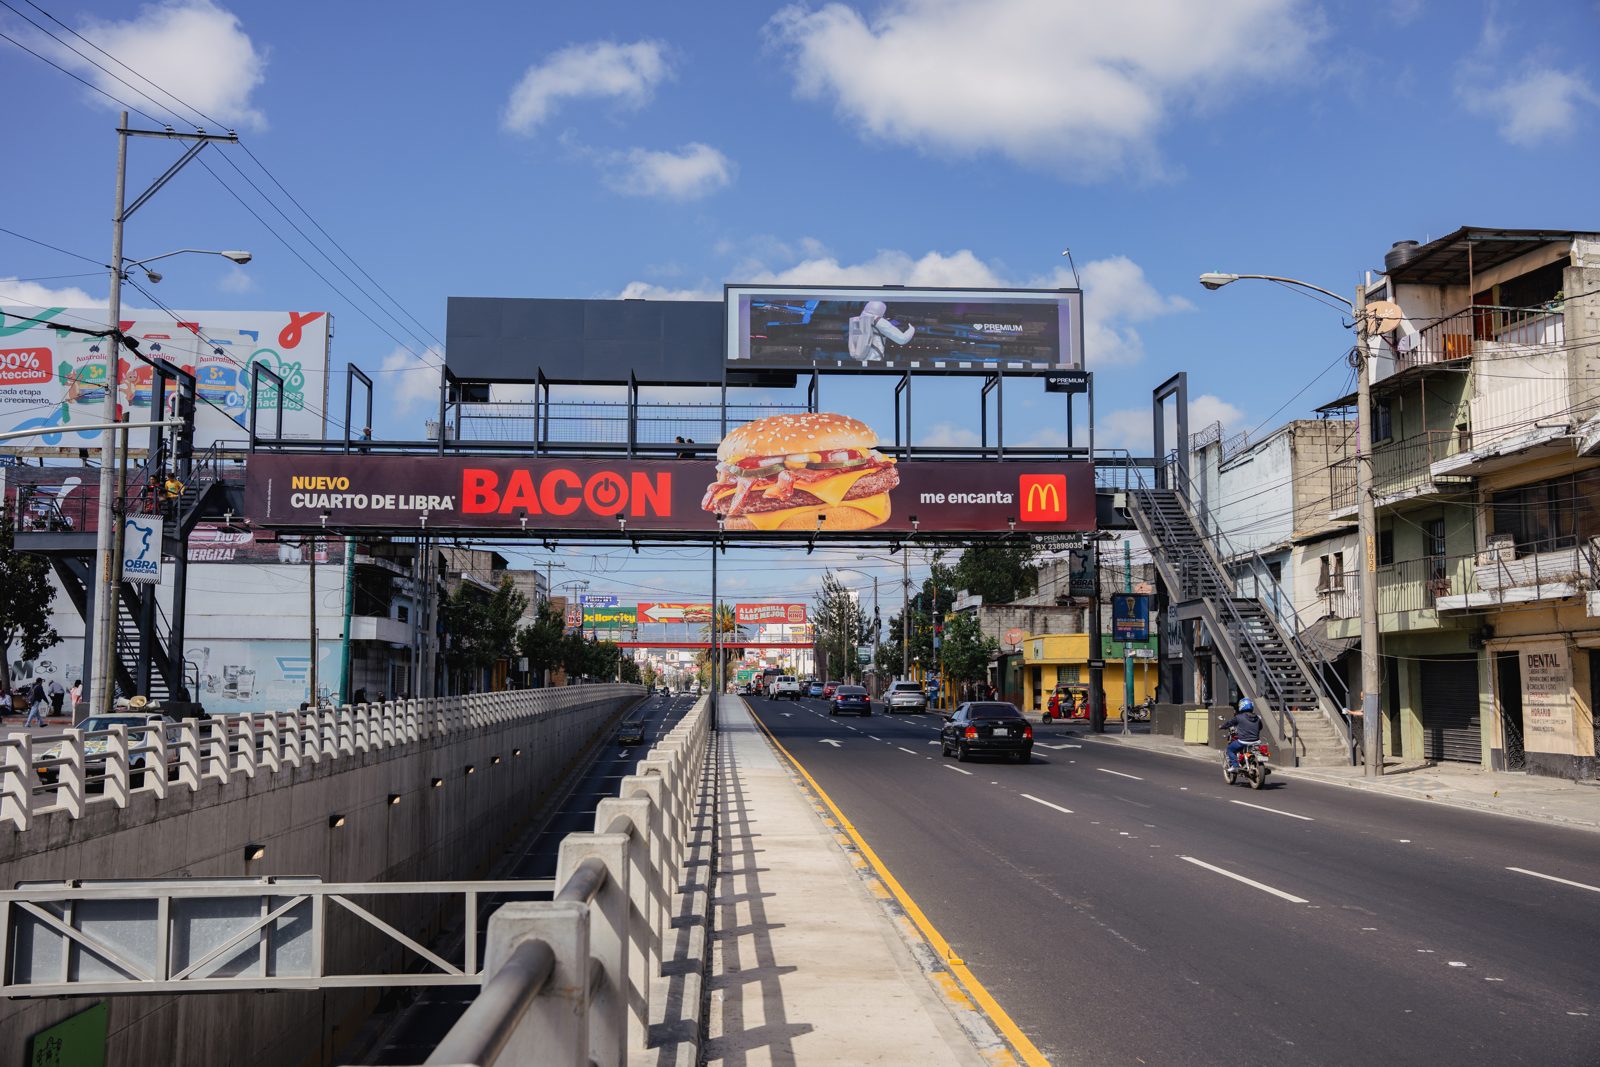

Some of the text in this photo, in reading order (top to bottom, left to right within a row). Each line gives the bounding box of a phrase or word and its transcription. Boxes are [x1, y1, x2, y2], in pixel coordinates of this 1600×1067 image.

[984, 324, 1023, 332] PREMIUM
[76, 353, 107, 363] Australi
[89, 366, 103, 379] 3+
[210, 367, 224, 379] 5+
[19, 389, 42, 397] etapa
[292, 476, 350, 490] NUEVO
[462, 468, 672, 516] BACON
[920, 491, 1012, 504] me encanta
[290, 493, 368, 509] CUARTO
[371, 494, 395, 509] DE
[1048, 542, 1082, 550] 23898035
[187, 548, 236, 560] NERGIZA!
[124, 559, 157, 569] OBRA
[583, 612, 636, 624] Dollarcity
[1527, 654, 1560, 668] DENTAL
